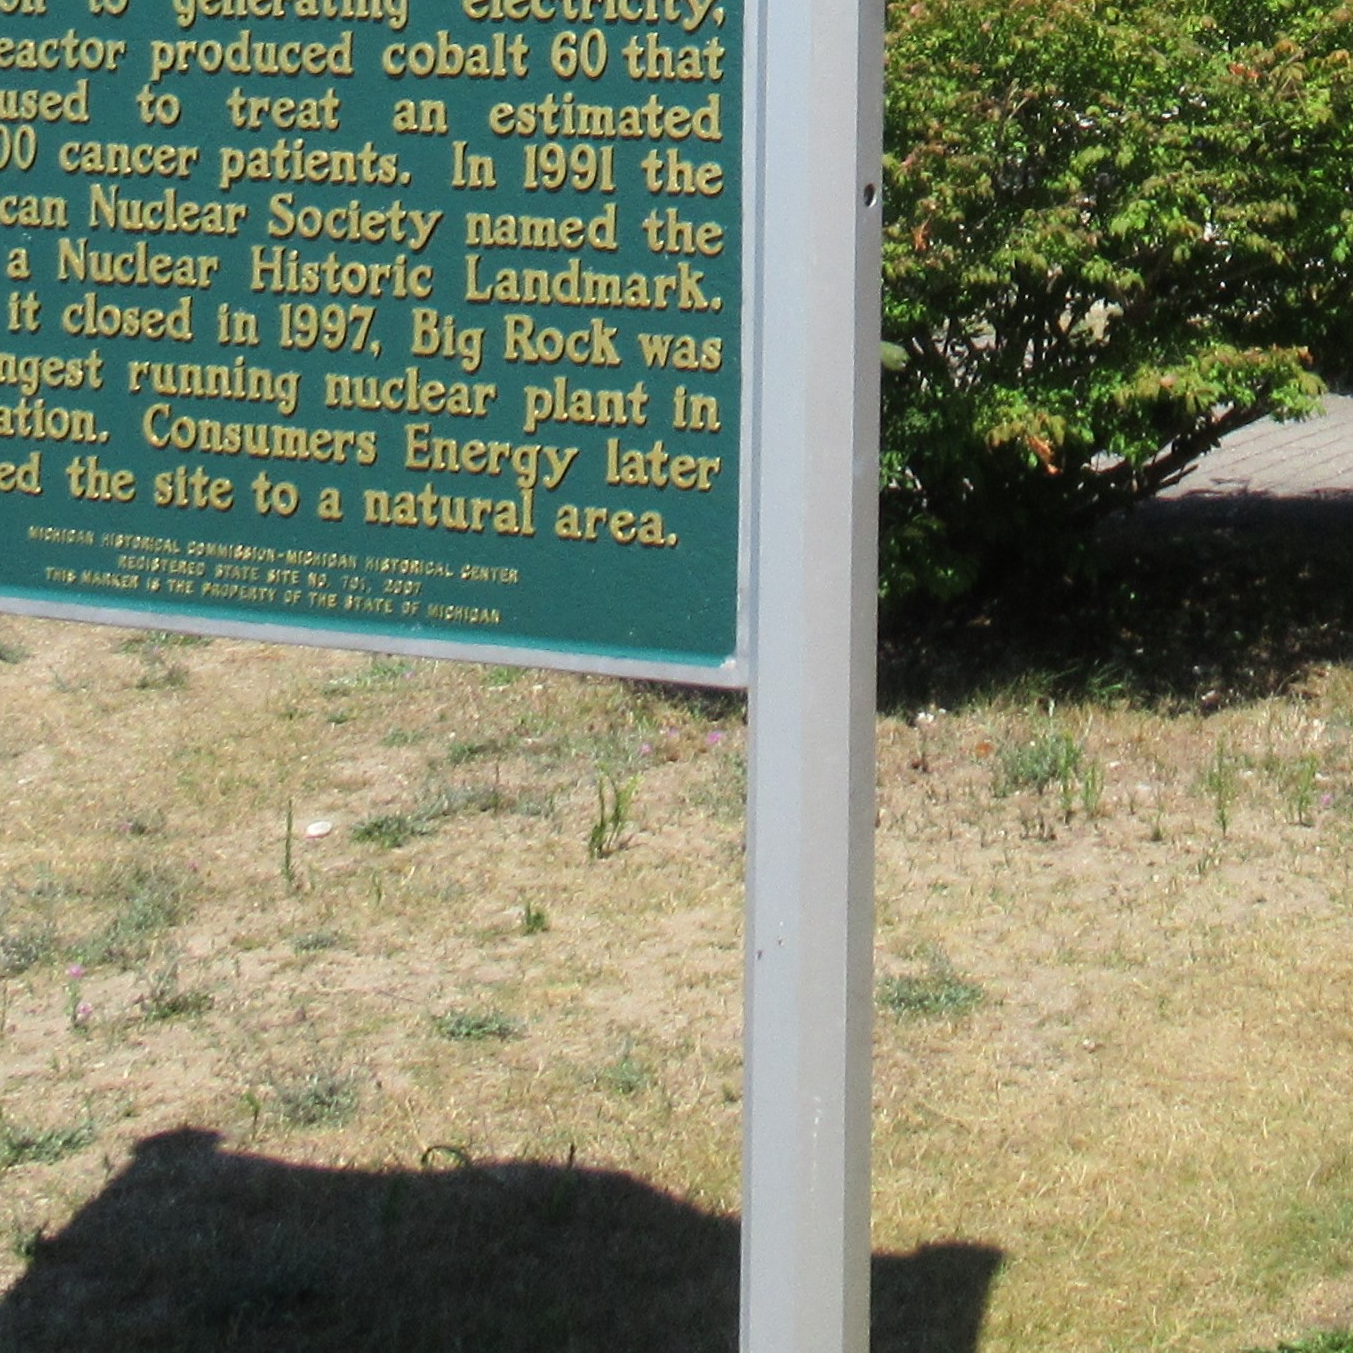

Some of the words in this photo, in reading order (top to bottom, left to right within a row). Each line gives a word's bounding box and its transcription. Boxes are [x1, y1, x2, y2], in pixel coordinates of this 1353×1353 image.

[152, 31, 353, 80] produced
[383, 31, 528, 76] cobalt
[551, 29, 607, 77] 60
[623, 33, 724, 79] that
[138, 87, 179, 124] to
[228, 90, 339, 129] treat
[394, 101, 448, 133] an
[489, 94, 722, 140] estimated
[60, 143, 198, 175] cancer
[220, 140, 410, 188] patients.
[452, 142, 496, 187] In
[524, 143, 614, 191] 1991
[641, 149, 722, 195] the
[90, 185, 246, 233] Nuclear
[268, 194, 441, 249] Society
[467, 204, 617, 249] named
[643, 209, 722, 255] the
[7, 249, 30, 278] a
[59, 239, 218, 287] Nuclear
[251, 246, 431, 297] Historic
[466, 255, 721, 310] Landmark.
[10, 293, 39, 330] it
[63, 293, 193, 340] closed
[219, 305, 259, 344] in
[281, 304, 379, 355] 1997,
[412, 309, 483, 371] Big
[505, 315, 620, 365] Rock
[638, 335, 721, 370] was
[130, 358, 299, 414] running
[326, 368, 495, 416] nuclear
[524, 378, 648, 432] plant
[673, 387, 720, 430] in
[143, 404, 376, 463] Consumers
[406, 424, 578, 489] Energy
[607, 439, 720, 489] later
[65, 455, 137, 502] the
[153, 464, 234, 512] site
[251, 470, 300, 515] to
[318, 487, 343, 520] a
[363, 483, 537, 535] natural
[554, 504, 679, 547] area.
[28, 525, 95, 546] MICHIGAN
[101, 532, 181, 555] HISTORICAL
[365, 555, 454, 578] HISTORICAL
[460, 564, 520, 585] CENTER
[117, 554, 205, 577] REGISTERED
[214, 563, 259, 581] STATE
[266, 568, 301, 585] SITE
[45, 566, 77, 584] THIS
[81, 569, 140, 589] MARKER
[146, 576, 160, 592] IS
[167, 578, 195, 595] THE
[201, 582, 277, 603] PROPERTY
[283, 589, 303, 605] OF
[309, 591, 339, 609] THE
[343, 594, 393, 614] STATE
[402, 600, 421, 616] OF
[427, 603, 502, 625] MICHIGAN
